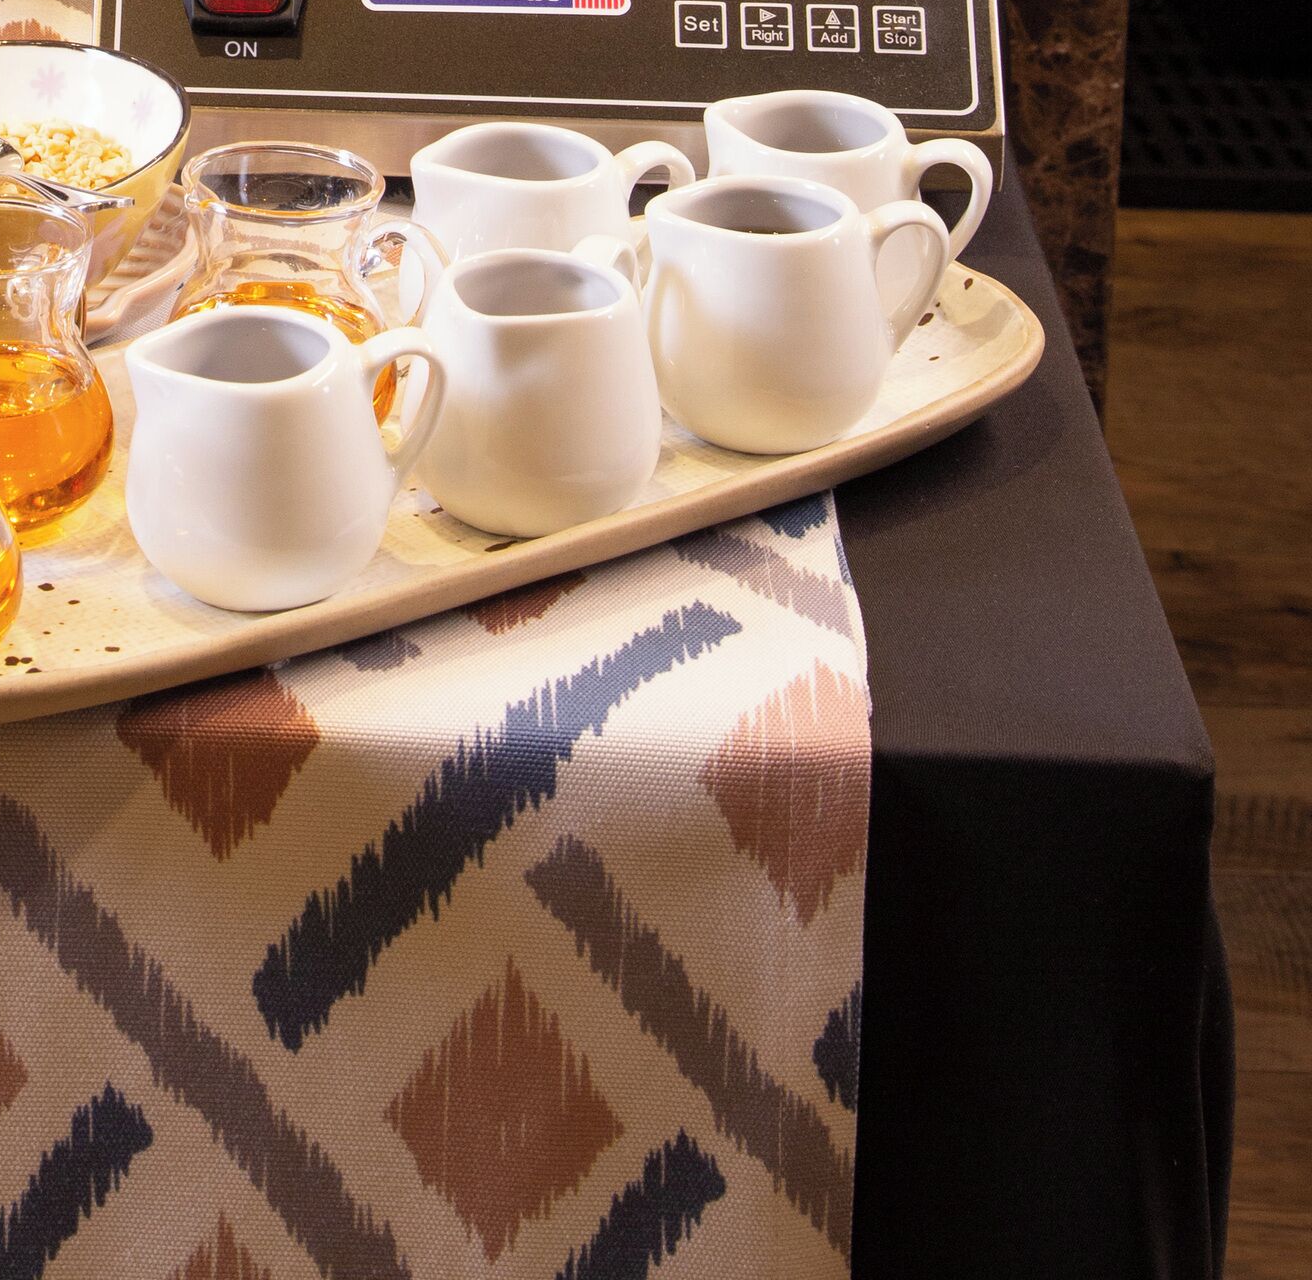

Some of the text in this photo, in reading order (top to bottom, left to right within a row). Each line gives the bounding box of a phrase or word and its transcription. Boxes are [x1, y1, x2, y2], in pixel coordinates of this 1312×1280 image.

[684, 16, 719, 32] Set
[882, 14, 917, 25] Start
[752, 29, 784, 43] Right
[820, 31, 848, 44] Add
[884, 32, 917, 47] Stop
[224, 40, 258, 58] ON
